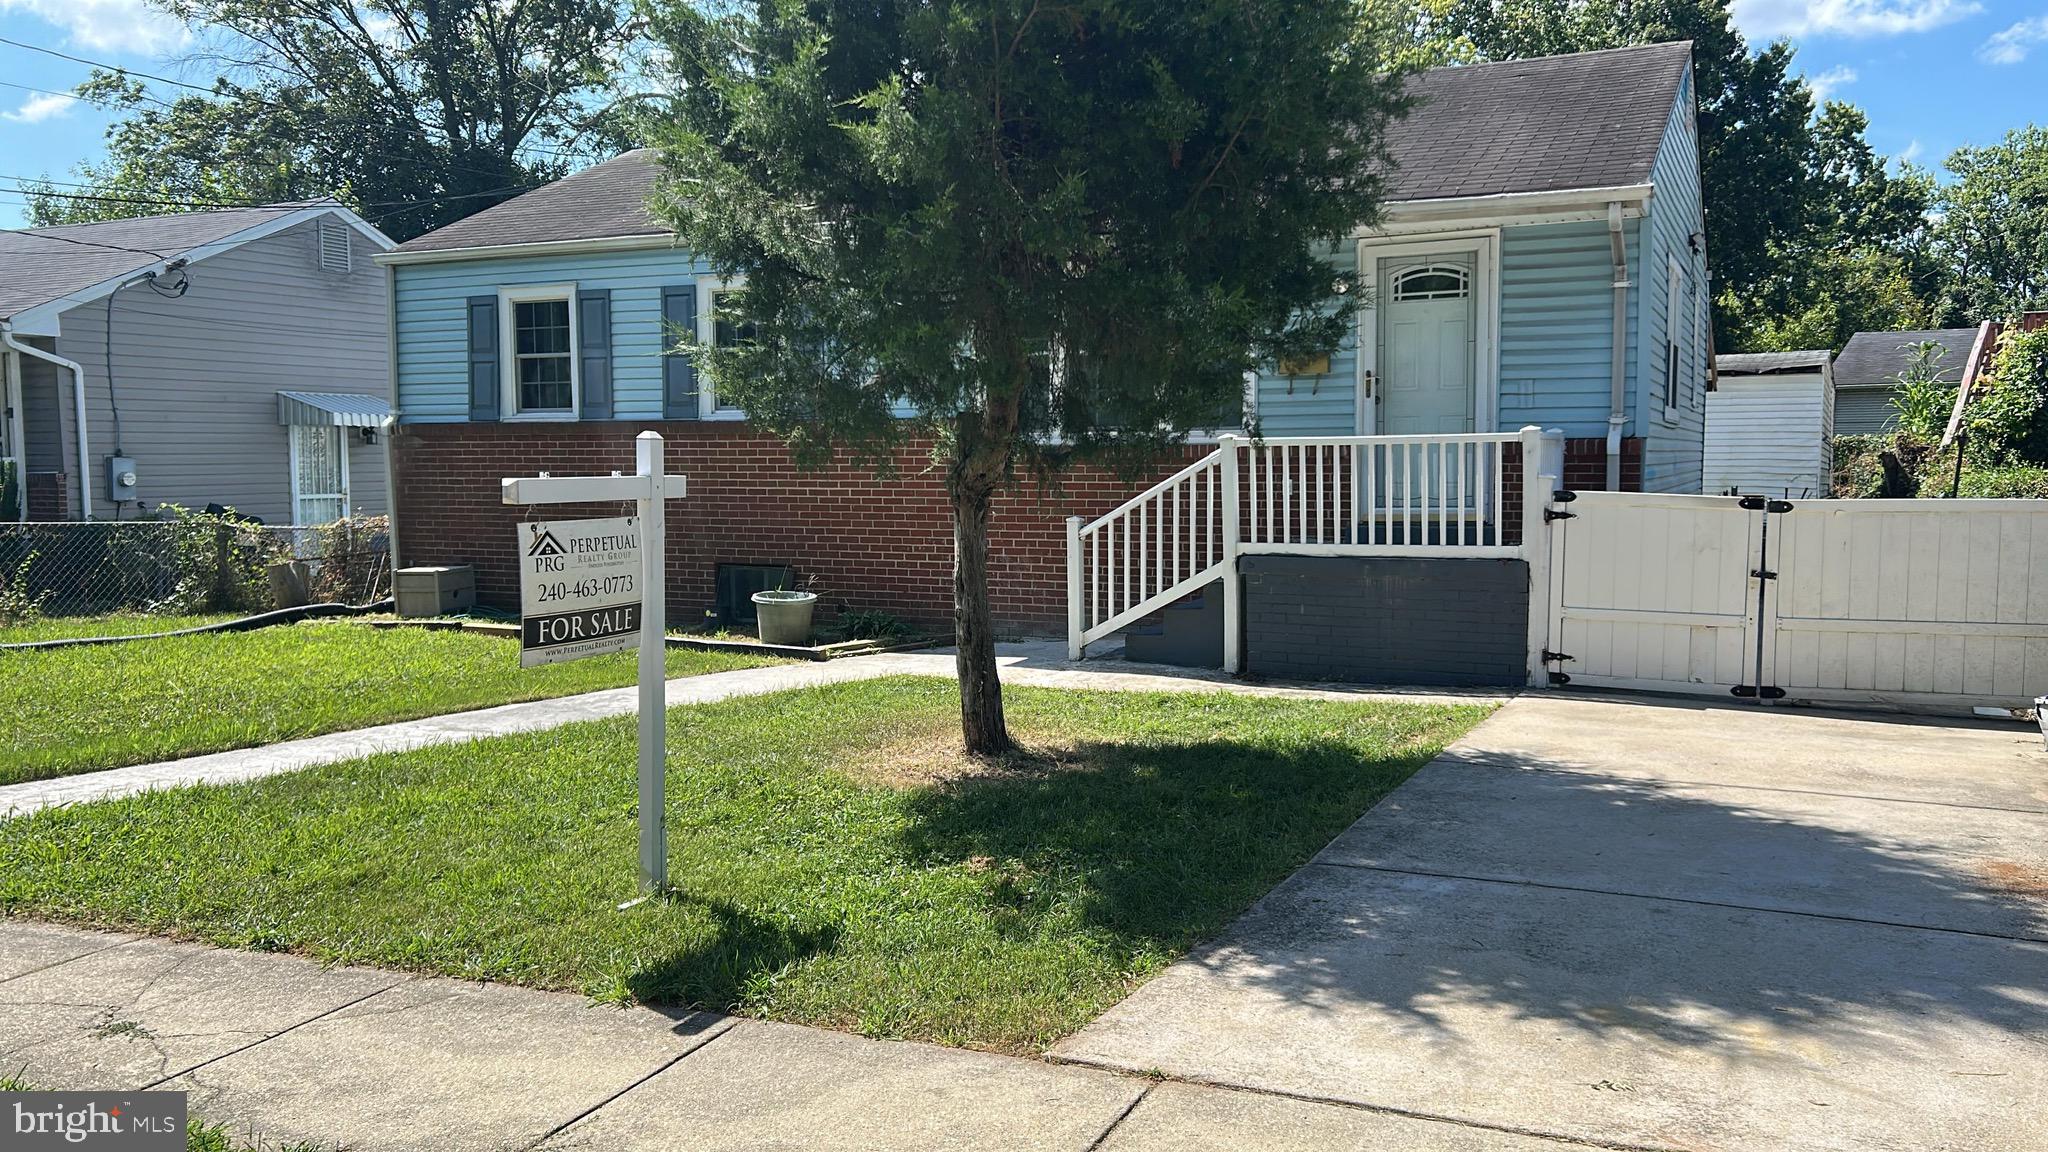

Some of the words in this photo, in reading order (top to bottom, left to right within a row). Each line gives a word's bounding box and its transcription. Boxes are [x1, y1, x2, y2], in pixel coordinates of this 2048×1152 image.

[570, 534, 637, 553] PERPETUAL
[535, 556, 565, 573] PRG
[538, 574, 634, 602] 240-463-0773
[538, 615, 586, 644] FOR
[590, 608, 633, 636] SALE
